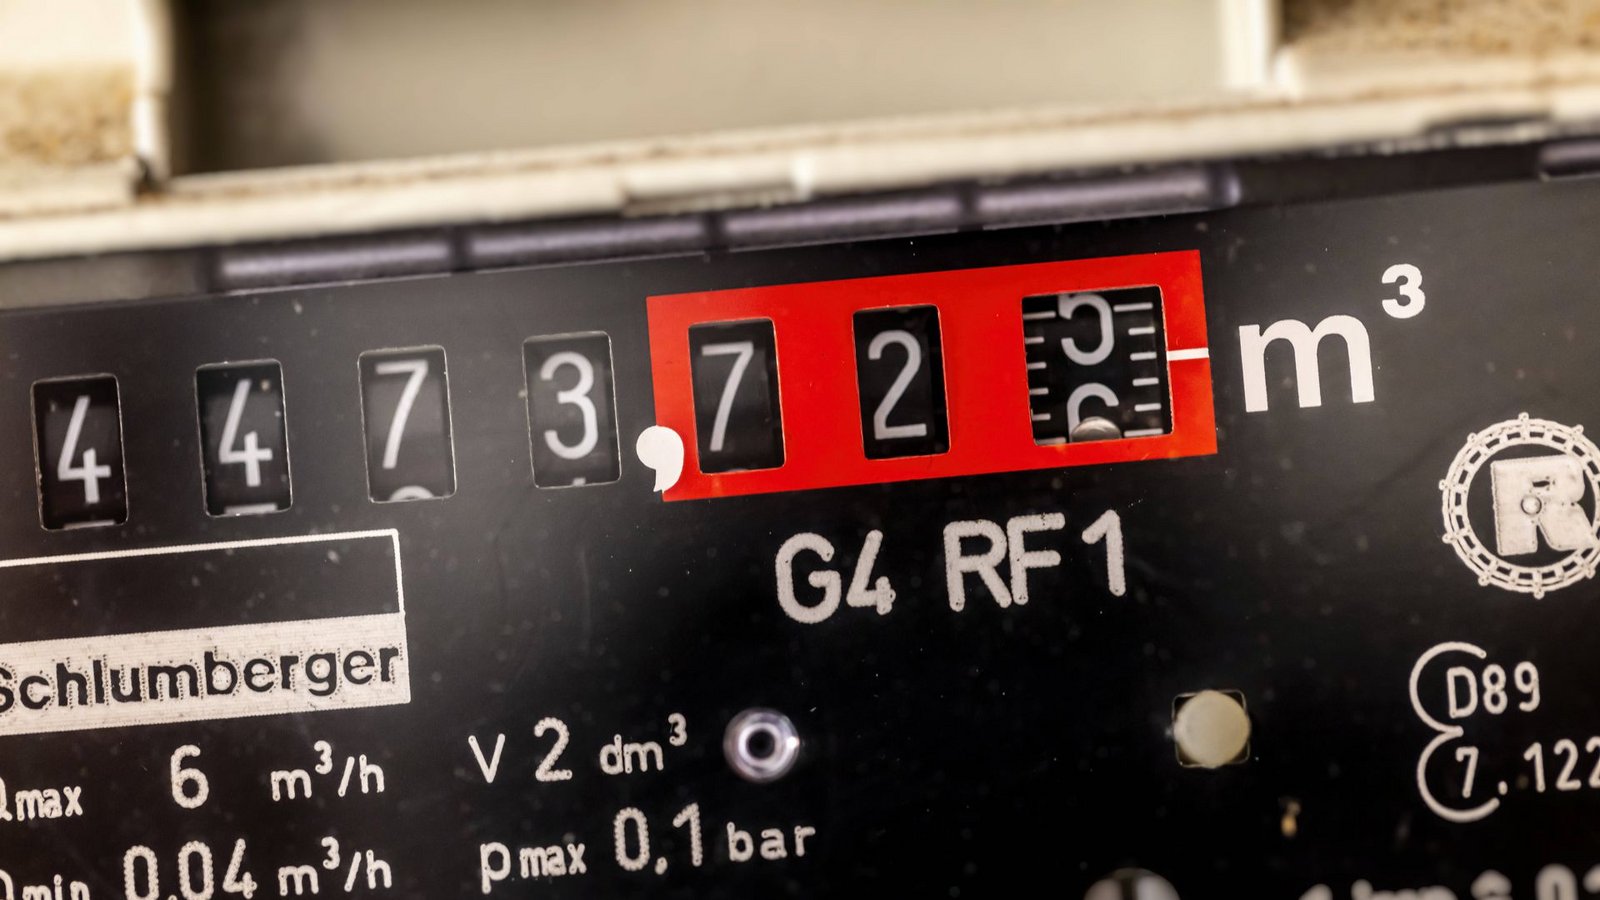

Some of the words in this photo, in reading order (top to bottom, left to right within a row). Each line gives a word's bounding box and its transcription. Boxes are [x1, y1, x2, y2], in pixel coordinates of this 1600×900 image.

[58, 397, 111, 503] 4
[218, 379, 273, 487] 4
[375, 359, 430, 469] 7
[702, 342, 754, 451] 7
[868, 331, 927, 439] 2
[775, 529, 897, 624] G4
[1446, 661, 1541, 719] D89
[170, 744, 210, 809] 6
[467, 733, 506, 784] V
[534, 717, 573, 782] 2
[613, 803, 703, 876] 0,1
[726, 821, 816, 862] bar
